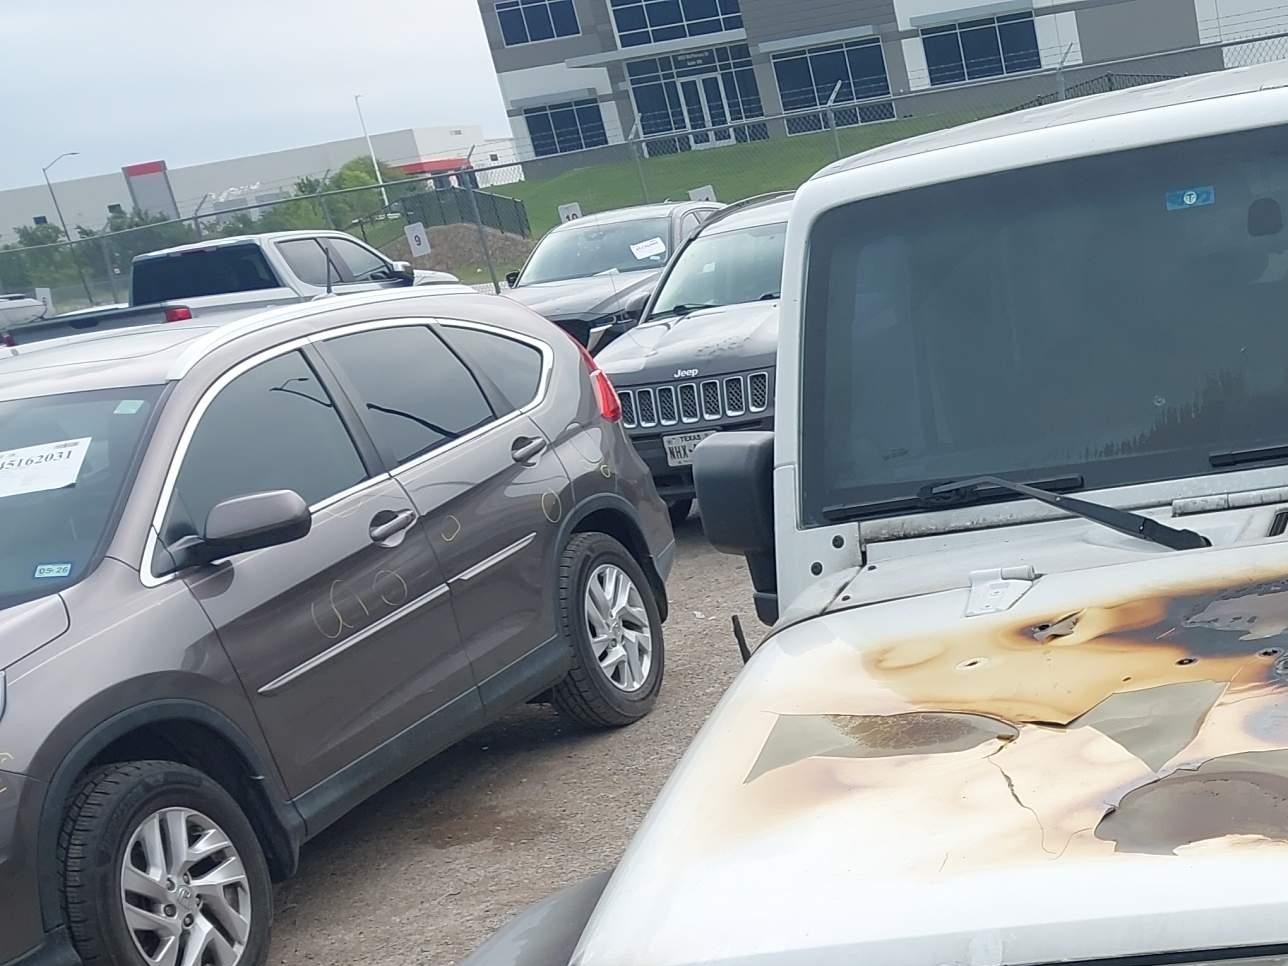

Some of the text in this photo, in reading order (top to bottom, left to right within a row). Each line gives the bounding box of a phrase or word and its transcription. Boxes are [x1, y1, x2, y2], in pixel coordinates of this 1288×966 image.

[414, 234, 422, 246] 9
[673, 368, 699, 378] Jeep
[680, 434, 701, 442] TEXAS
